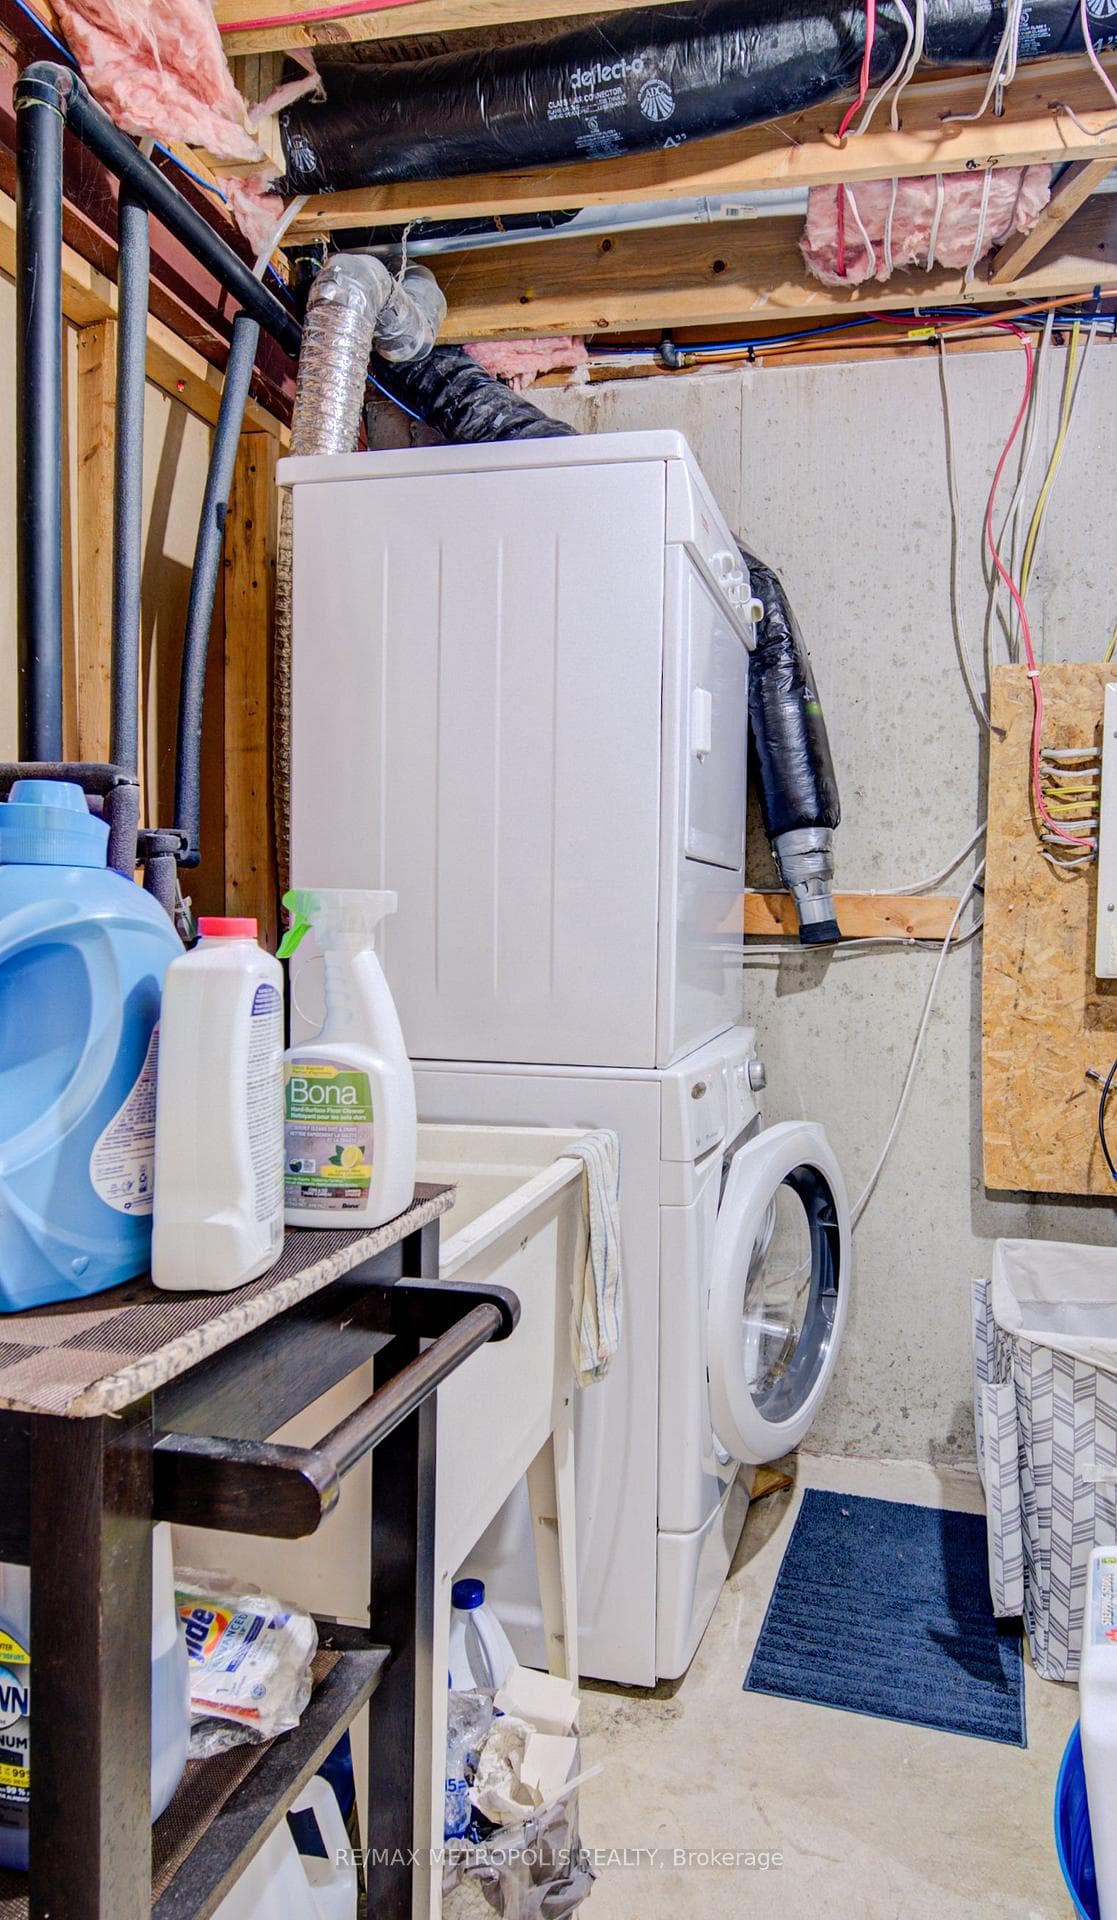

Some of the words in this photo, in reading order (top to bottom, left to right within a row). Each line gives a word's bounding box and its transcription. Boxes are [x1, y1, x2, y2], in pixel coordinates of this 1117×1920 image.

[570, 57, 644, 89] deflect-o
[584, 86, 623, 103] CONECTOR
[290, 1078, 358, 1105] Bona
